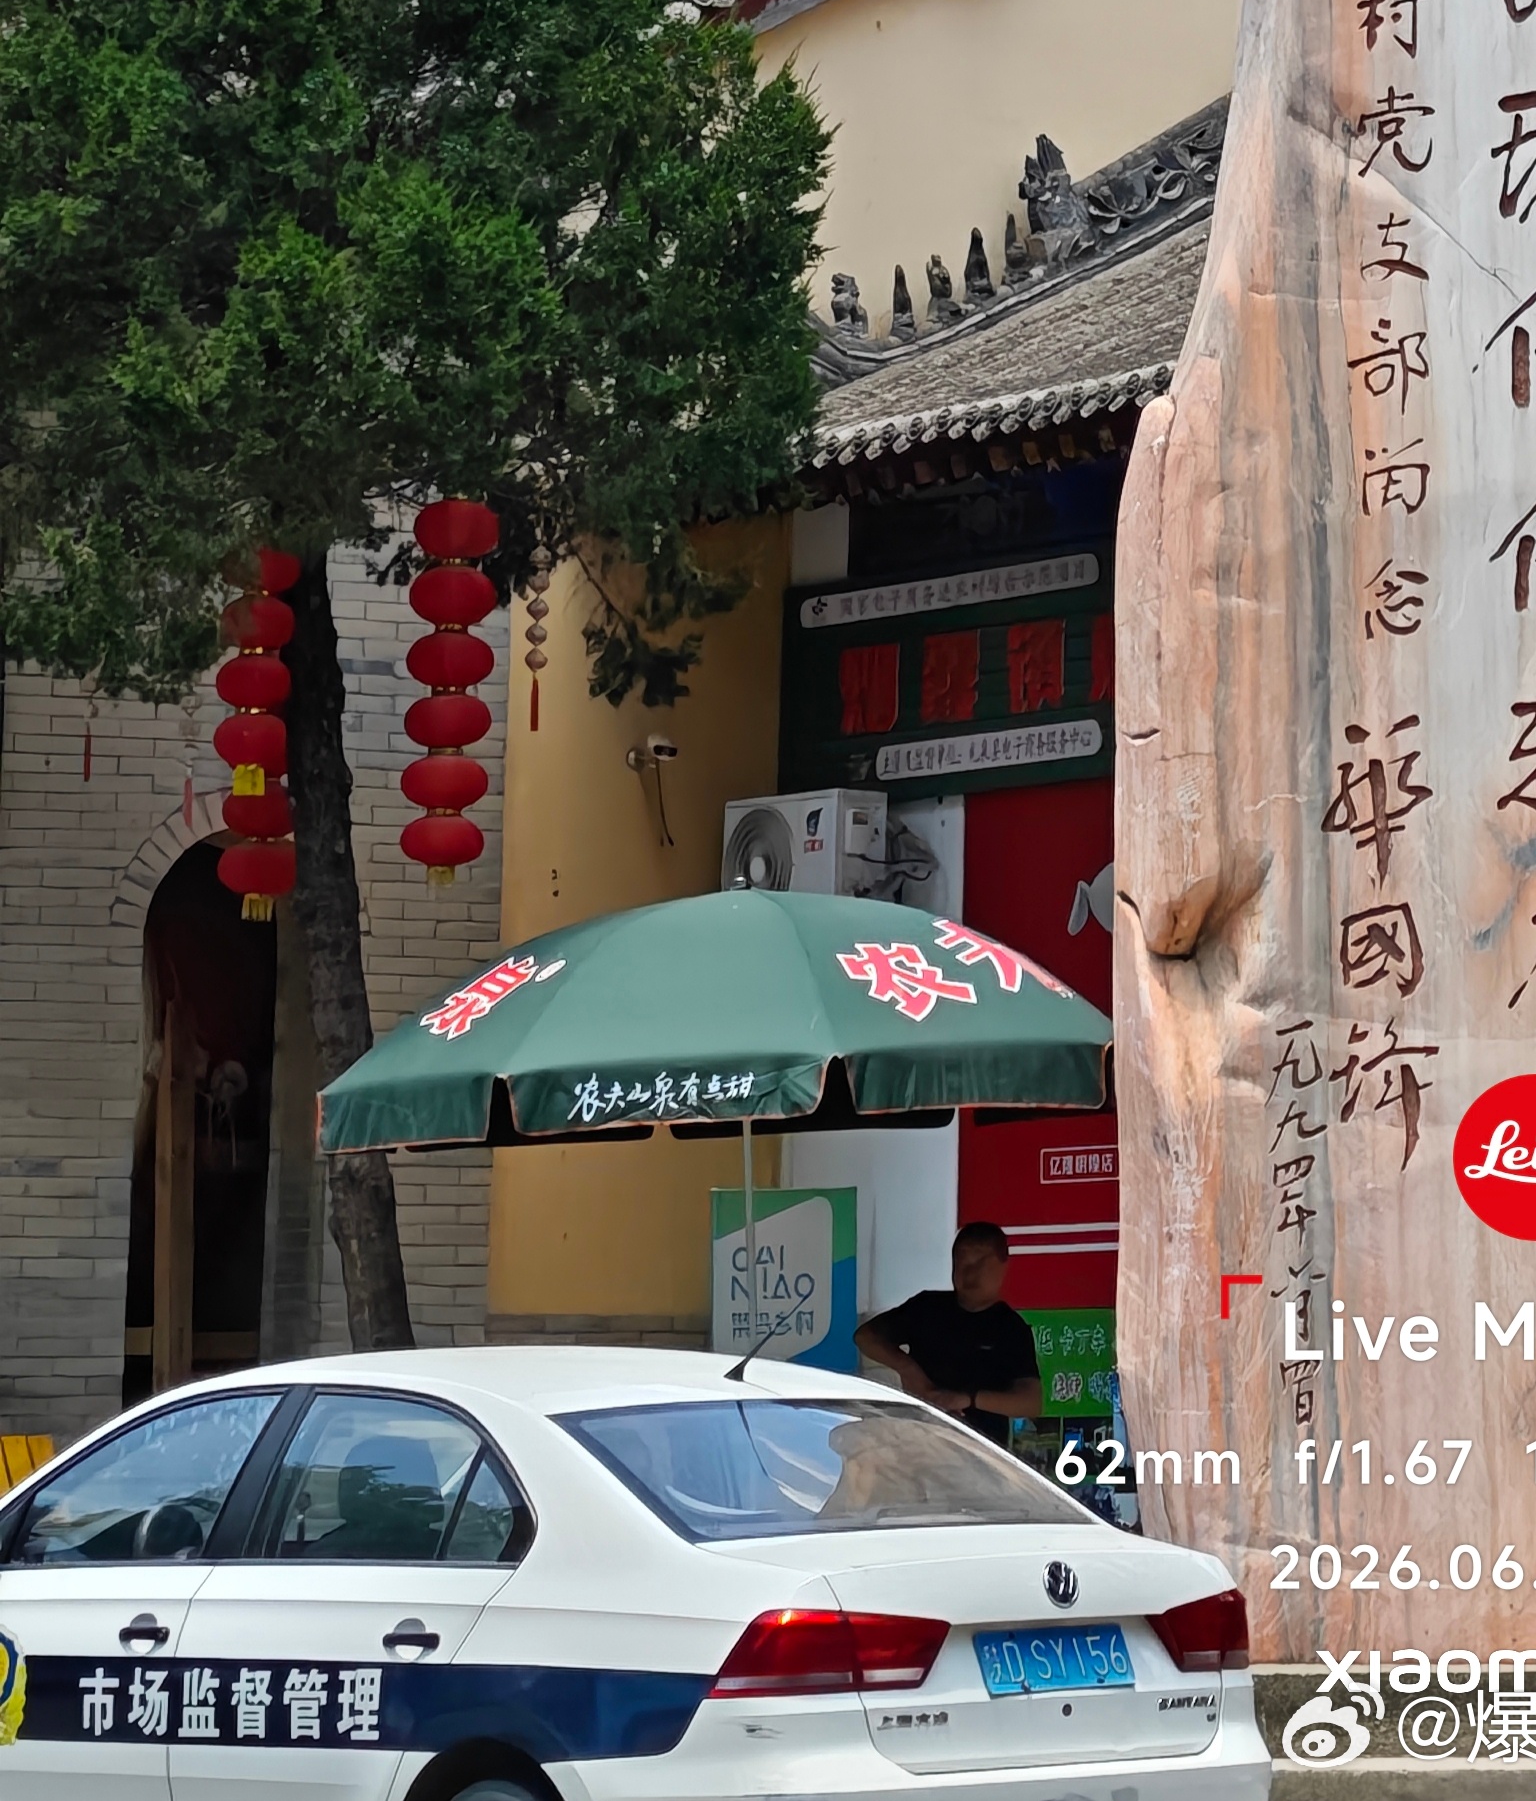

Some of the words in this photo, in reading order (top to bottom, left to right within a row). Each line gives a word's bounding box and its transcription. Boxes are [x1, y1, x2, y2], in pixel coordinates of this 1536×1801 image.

[567, 1070, 756, 1123] 农夫山泉有点甜
[78, 1666, 383, 1742] 市场监督管理
